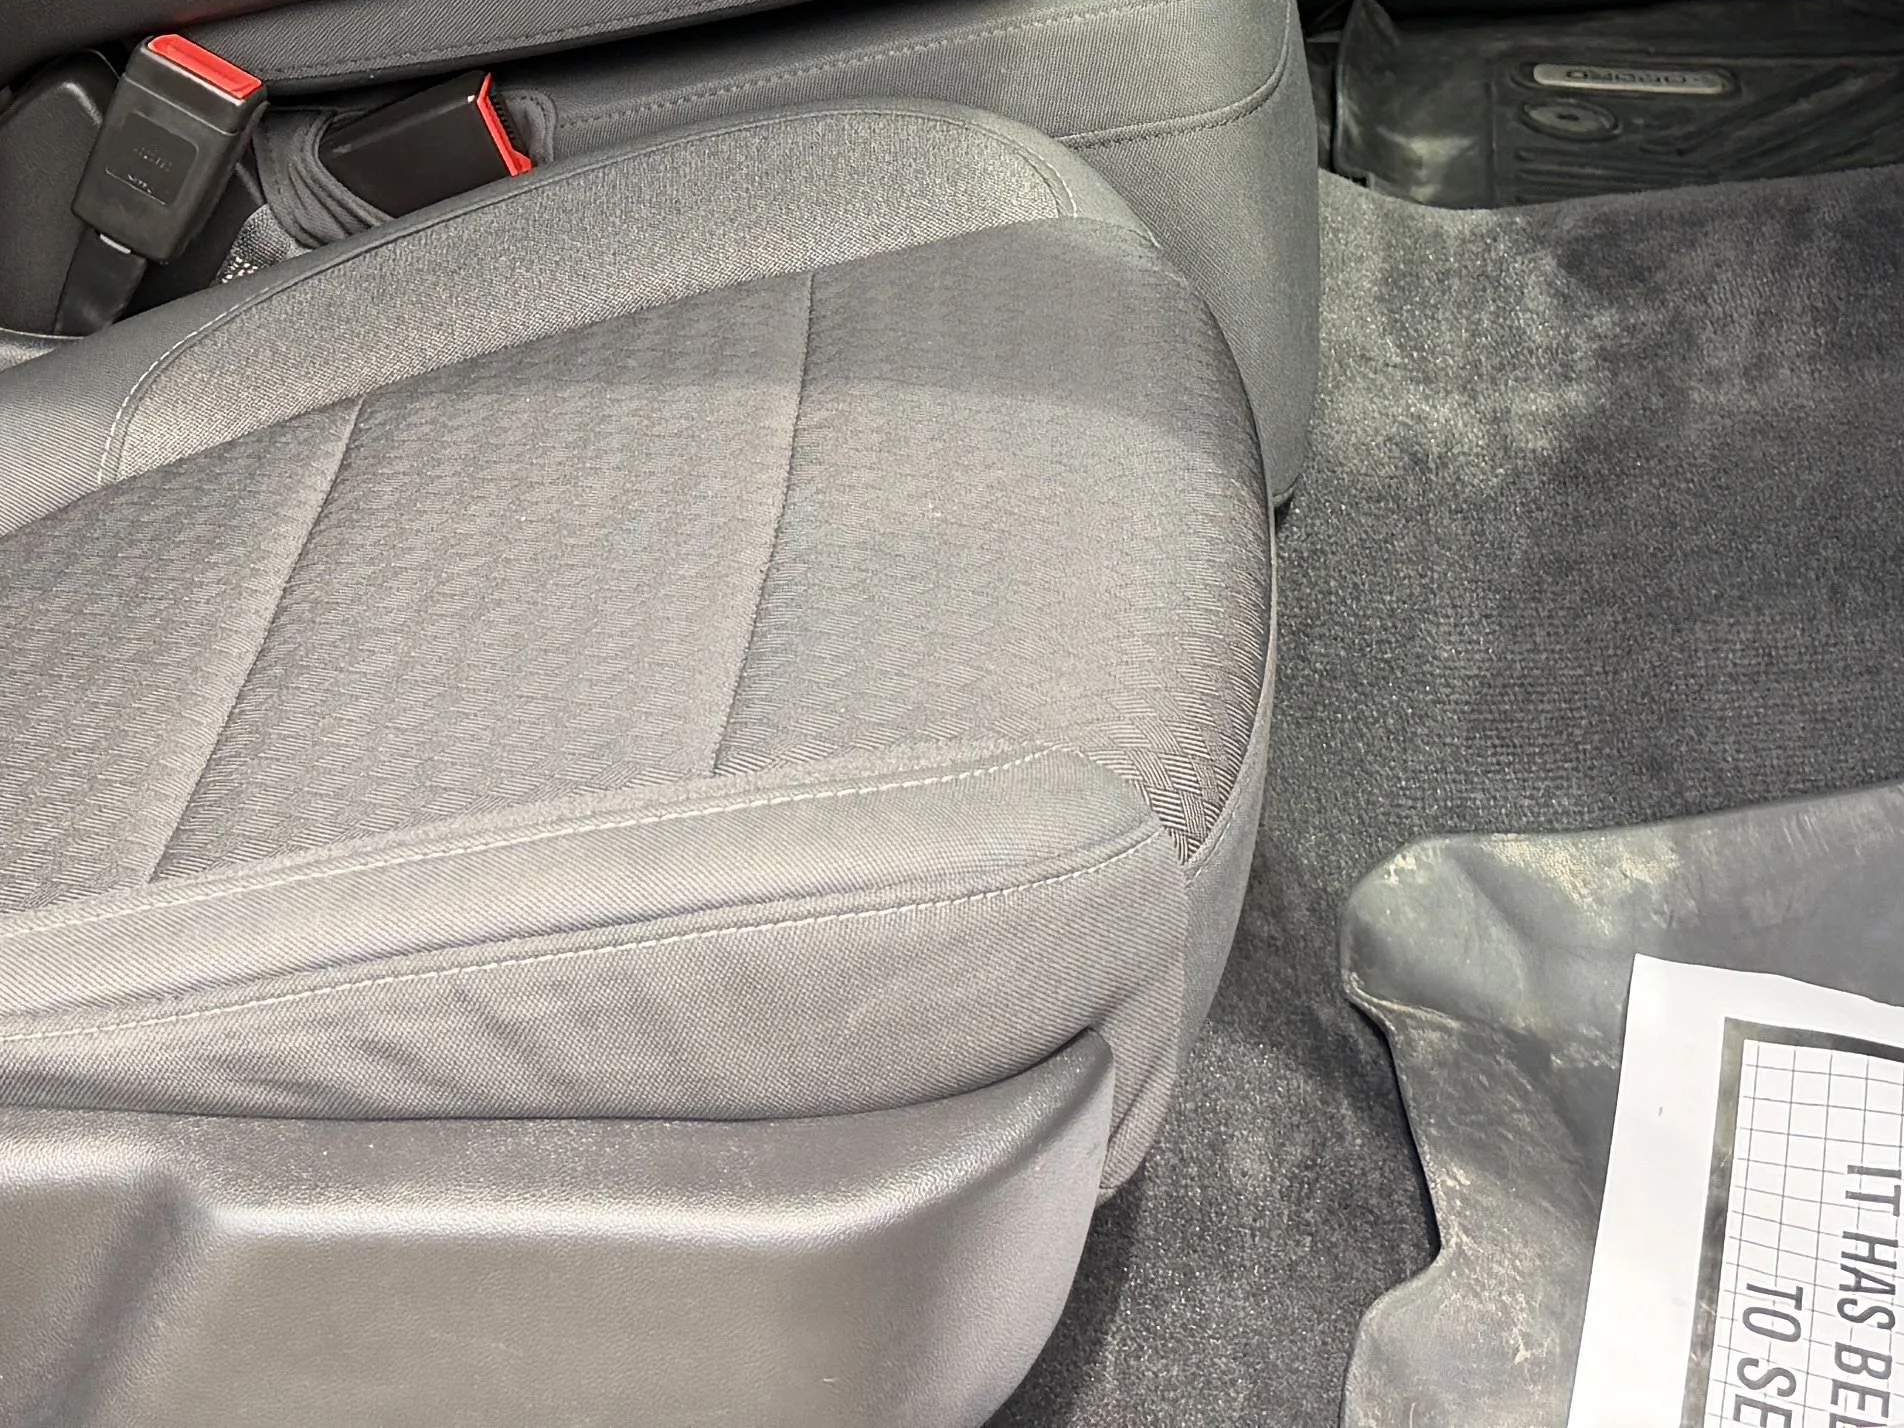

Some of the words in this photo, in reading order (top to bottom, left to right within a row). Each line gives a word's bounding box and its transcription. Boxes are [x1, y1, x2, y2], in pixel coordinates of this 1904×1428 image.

[1845, 1164, 1902, 1217] IT
[1836, 1230, 1899, 1331] HAS
[1742, 1282, 1804, 1343] TO
